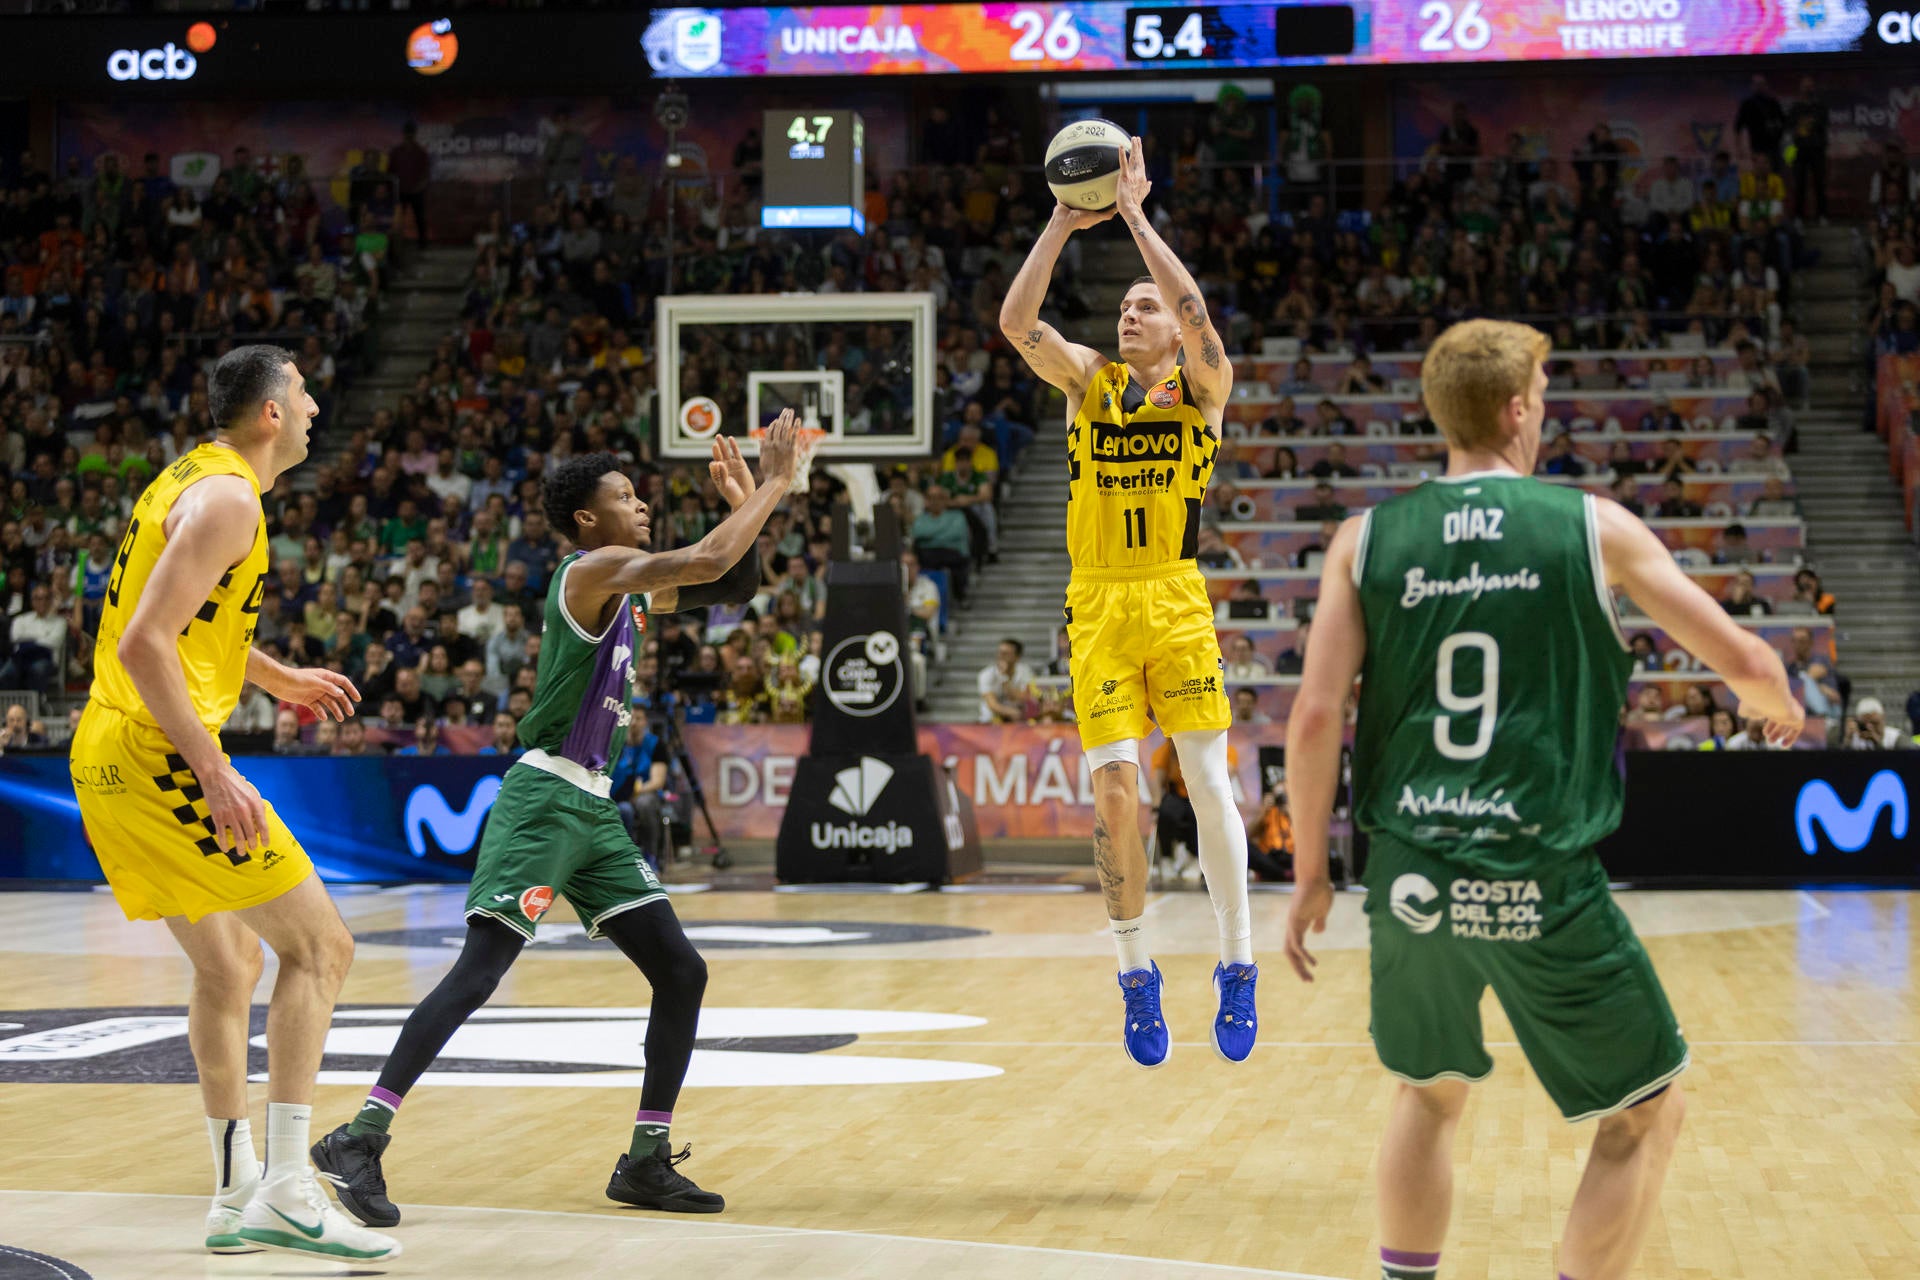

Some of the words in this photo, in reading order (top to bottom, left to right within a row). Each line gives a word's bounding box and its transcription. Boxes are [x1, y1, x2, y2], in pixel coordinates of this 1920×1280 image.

[781, 25, 917, 54] UNICAJA
[1010, 10, 1081, 61] 26
[1132, 13, 1207, 58] 5.4
[1419, 1, 1491, 51] 26
[1558, 23, 1686, 50] TENERIFE
[107, 42, 197, 80] acb
[787, 116, 833, 143] 4.7
[1085, 126, 1106, 138] 2024
[1093, 428, 1180, 457] Lenovo
[1123, 507, 1147, 549] 11
[1443, 504, 1504, 544] DÍAZ
[1433, 631, 1500, 760] 9
[811, 820, 913, 855] Unicaja
[1450, 878, 1543, 902] COSTA
[1450, 903, 1494, 923] DEL
[1497, 904, 1543, 923] SOL
[1451, 920, 1543, 942] MÁLAGA
